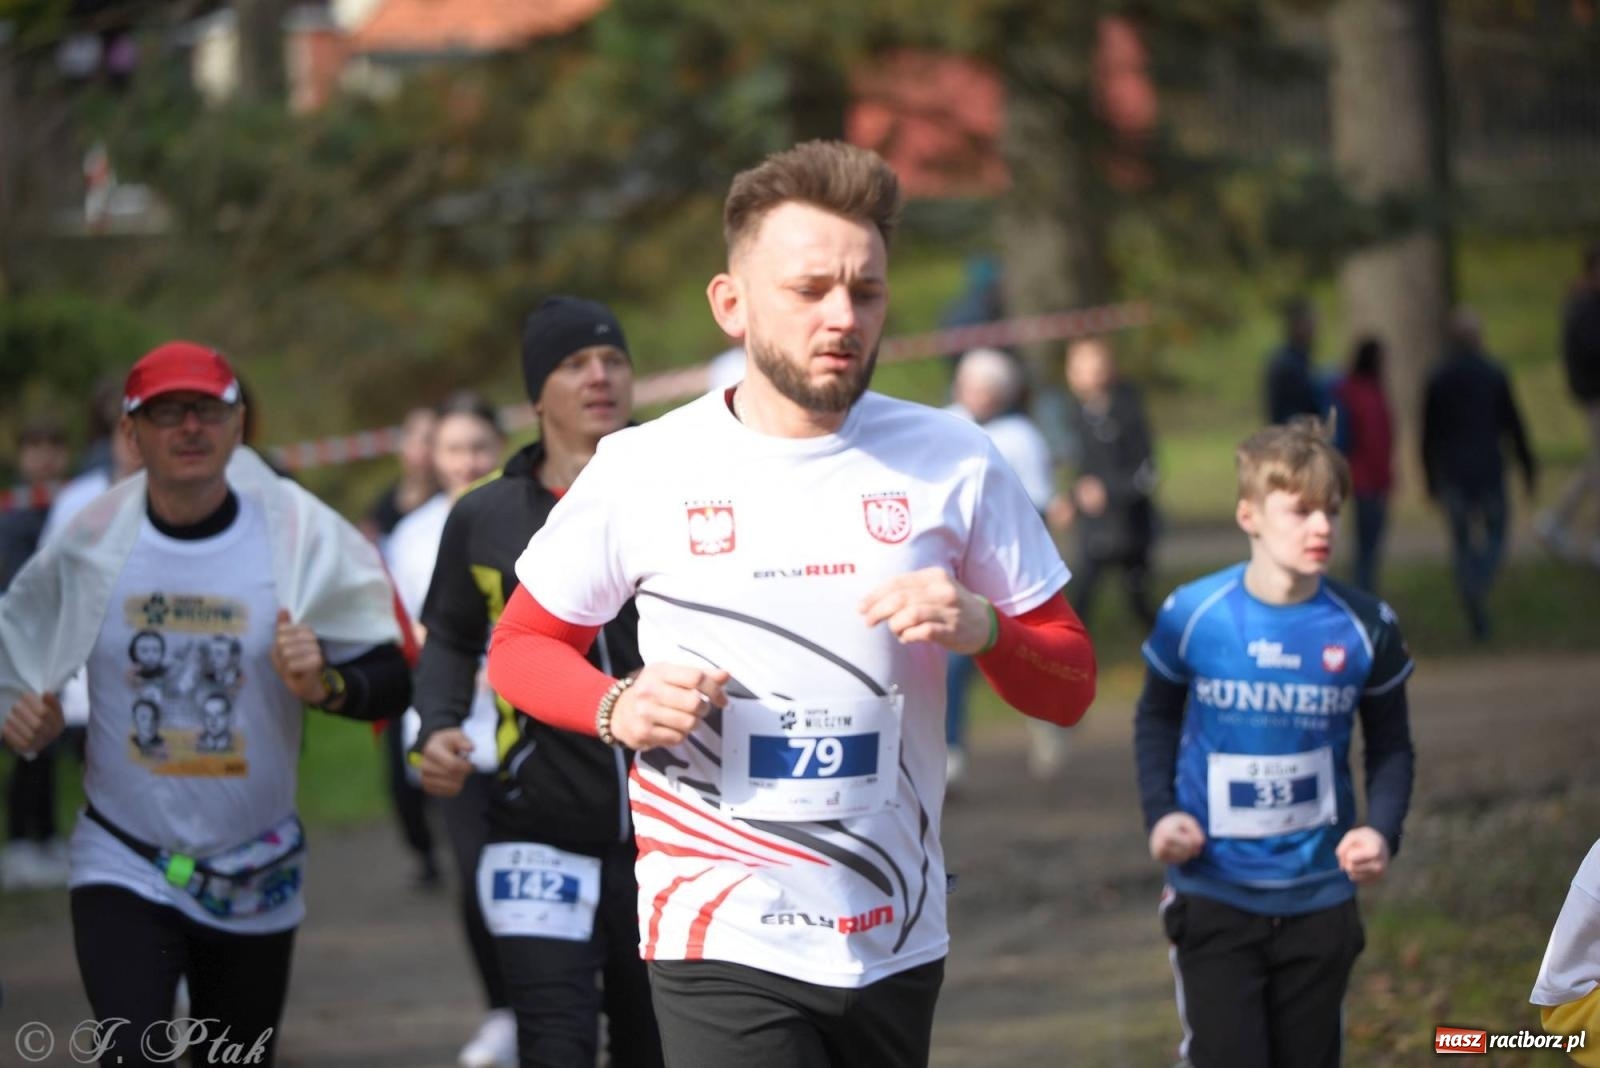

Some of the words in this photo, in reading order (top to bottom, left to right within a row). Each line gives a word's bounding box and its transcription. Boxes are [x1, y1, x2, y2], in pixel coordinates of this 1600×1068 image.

[1196, 677, 1357, 716] RUNNERS
[788, 737, 844, 777] 79
[1254, 779, 1294, 809] 33
[506, 870, 565, 901] 142
